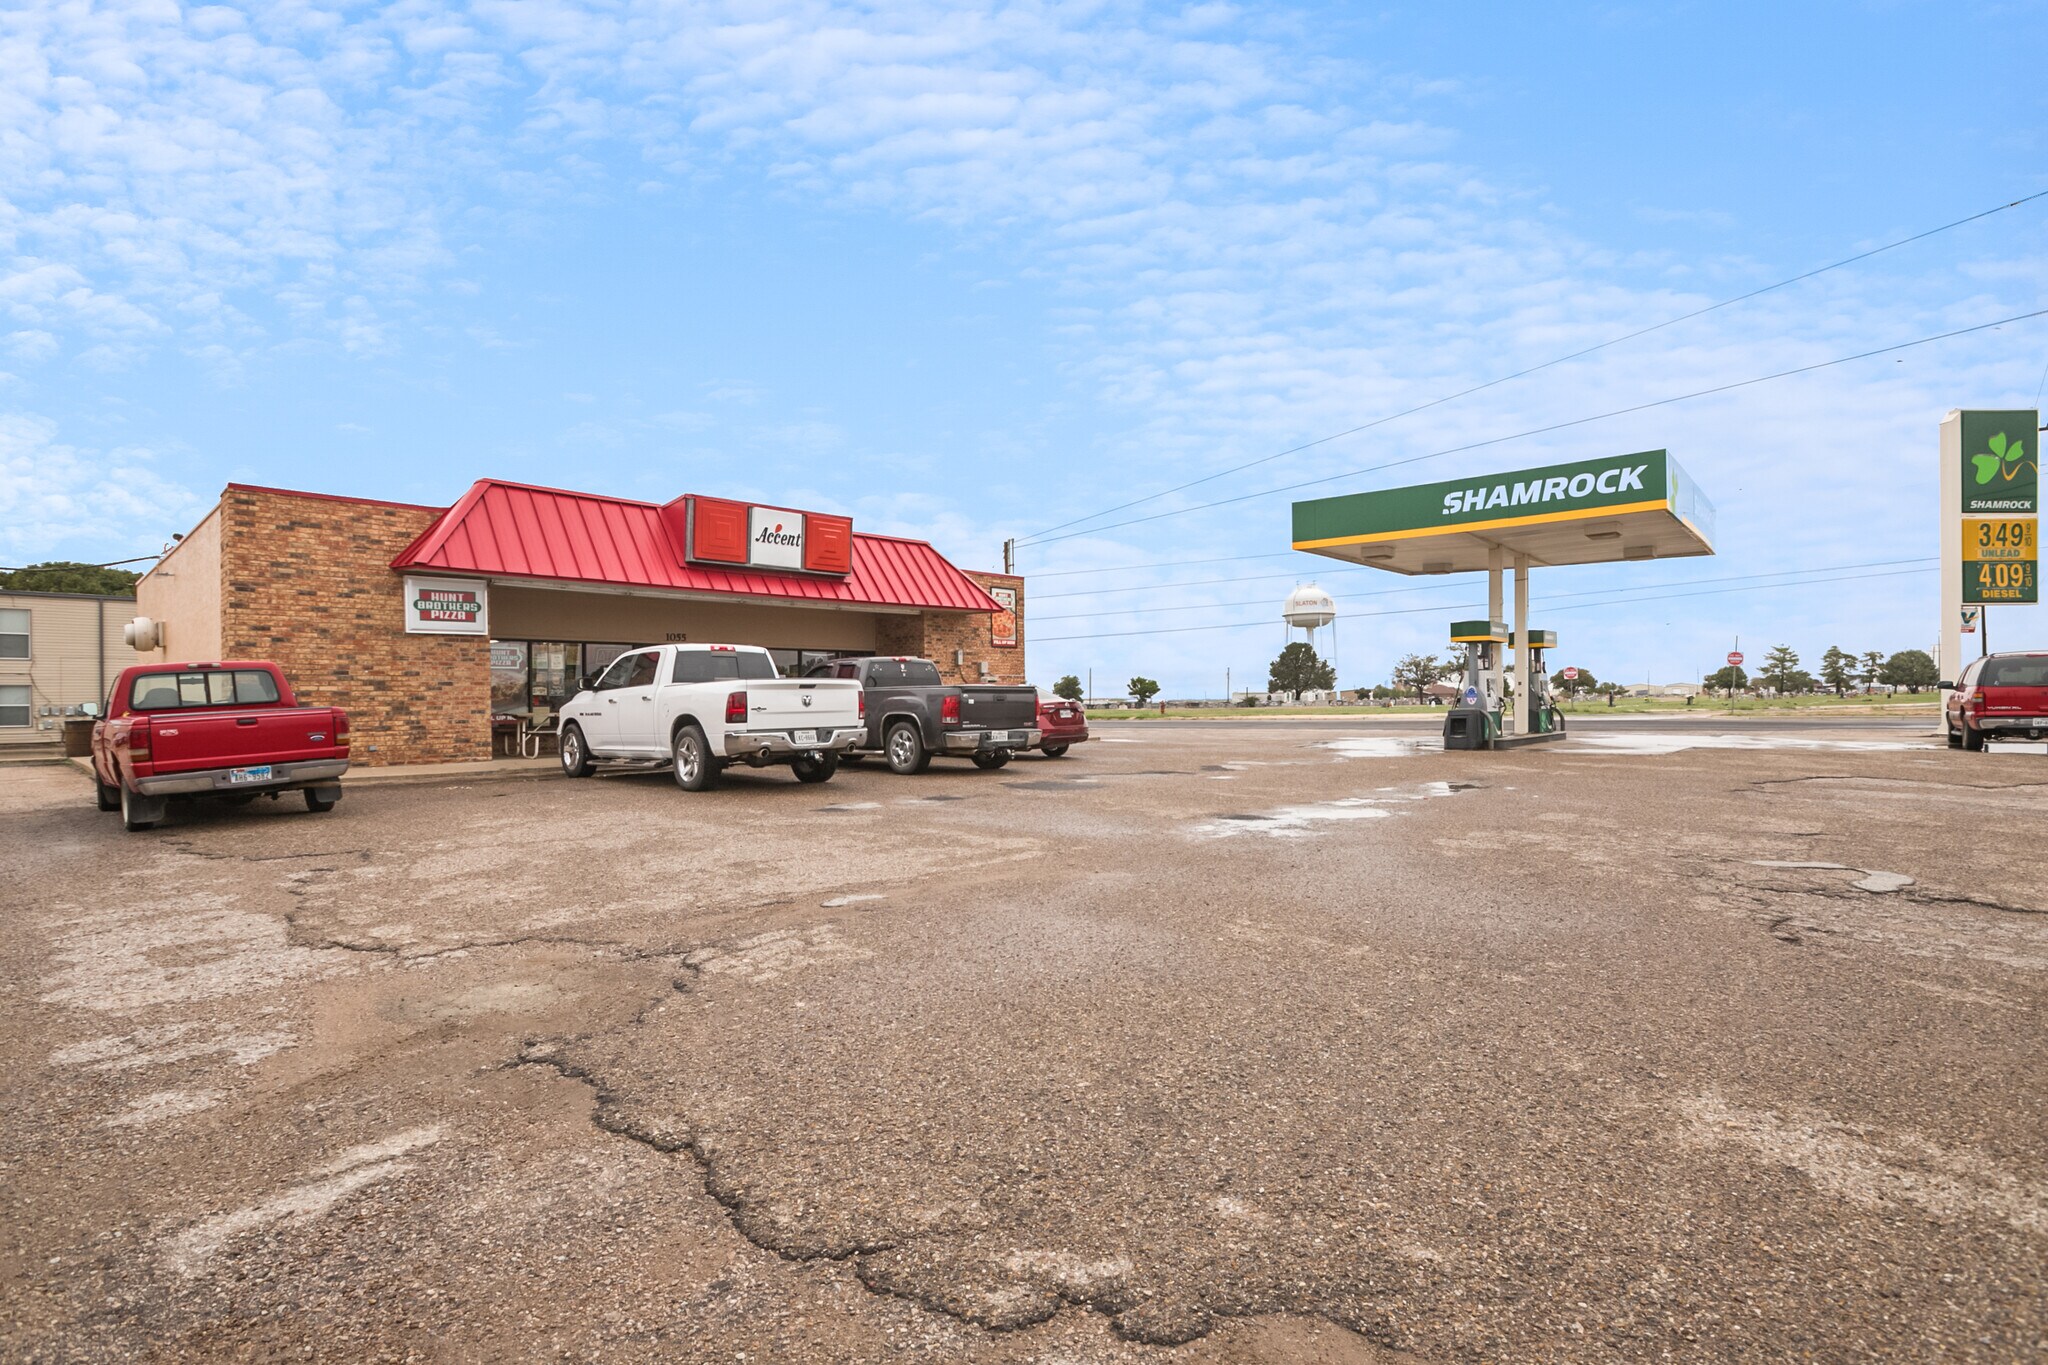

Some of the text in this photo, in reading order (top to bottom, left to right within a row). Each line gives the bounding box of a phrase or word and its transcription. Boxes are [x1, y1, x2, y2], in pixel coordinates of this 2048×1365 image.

[1442, 464, 1648, 515] SHAMROCK
[1970, 500, 2032, 509] SHAMROCK
[755, 526, 802, 547] Accent
[1979, 523, 2023, 547] 3.49
[1981, 549, 2020, 557] UNLEAD
[1979, 563, 2023, 587] 4.09
[431, 592, 464, 602] HUNT
[1982, 589, 2022, 598] DIESEL
[417, 600, 478, 612] BROTHERS
[431, 610, 466, 620] PIZZA
[665, 633, 687, 641] 1055
